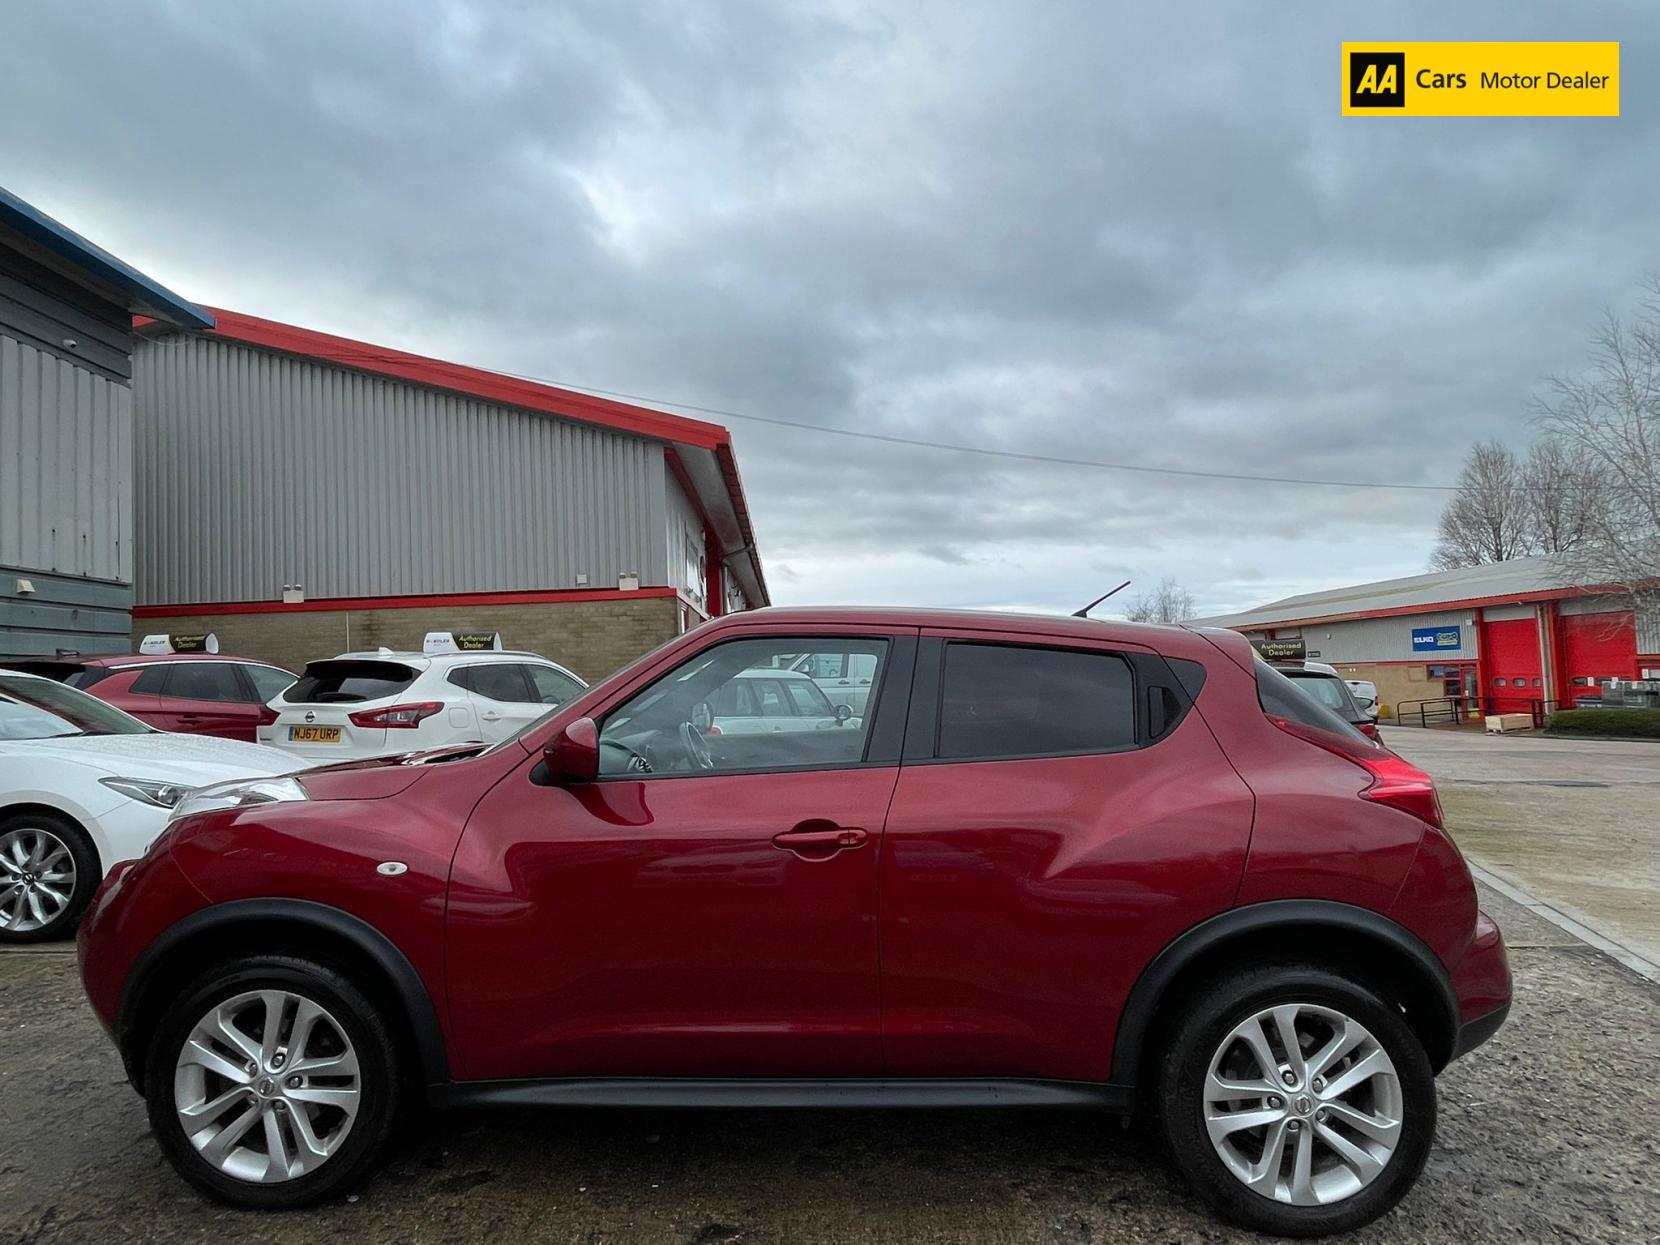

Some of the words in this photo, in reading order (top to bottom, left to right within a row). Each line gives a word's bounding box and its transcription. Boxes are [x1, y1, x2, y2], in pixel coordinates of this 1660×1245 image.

[463, 641, 485, 649] Dealer
[1261, 642, 1302, 650] Authorised
[294, 728, 318, 740] NJ67
[320, 728, 339, 740] URP
